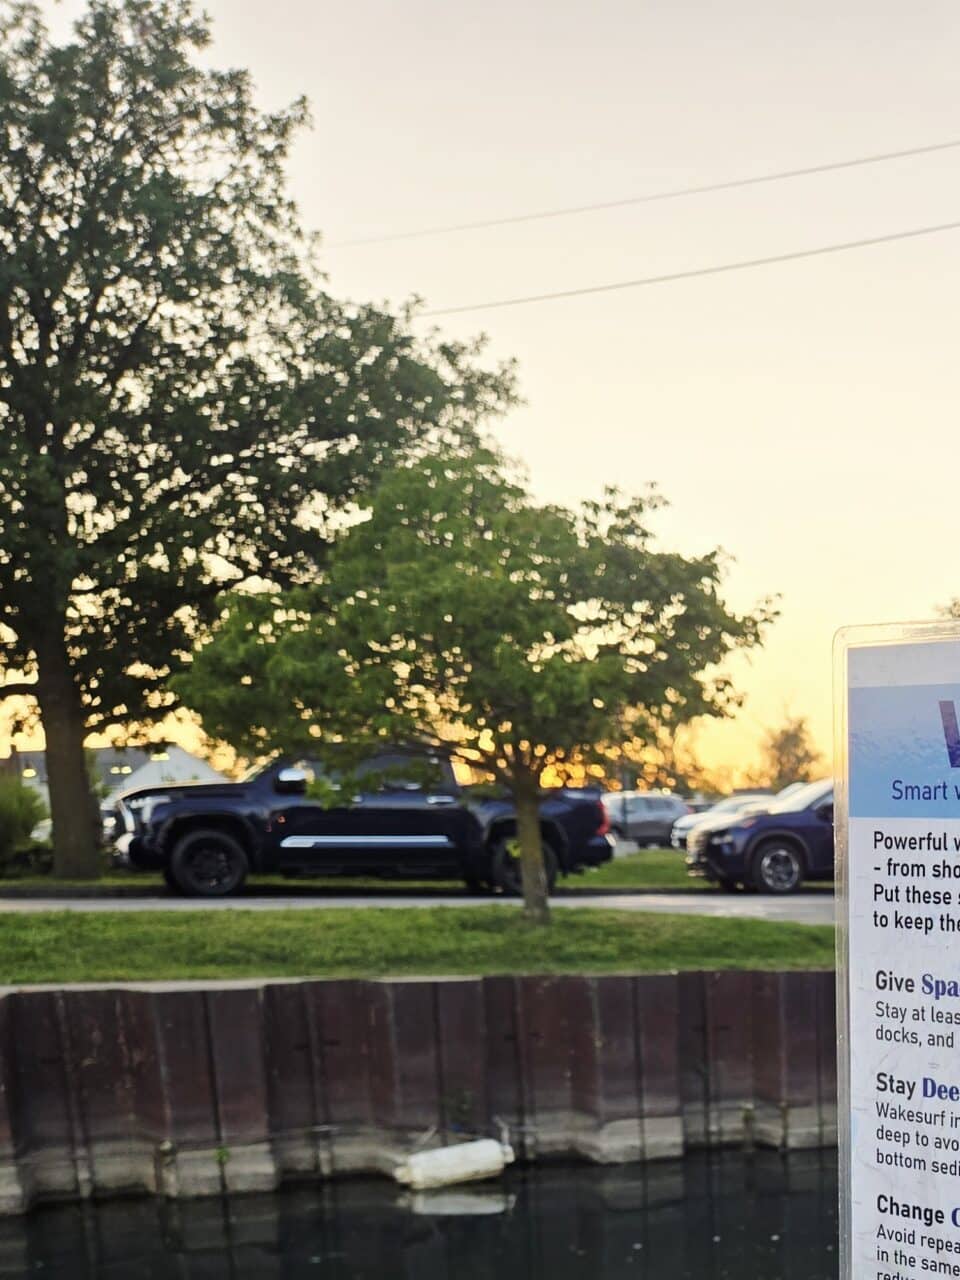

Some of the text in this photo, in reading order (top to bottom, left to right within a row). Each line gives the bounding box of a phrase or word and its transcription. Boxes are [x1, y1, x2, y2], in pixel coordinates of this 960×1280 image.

[892, 780, 947, 800] Smart
[874, 831, 947, 850] Powerful
[888, 858, 925, 877] from
[874, 884, 899, 902] Put
[906, 886, 951, 904] these
[874, 911, 888, 927] to
[895, 911, 933, 935] keep
[876, 971, 914, 992] Give
[876, 1001, 907, 1023] Stay
[912, 1007, 925, 1021] at
[876, 1025, 921, 1046] docks,
[928, 1032, 953, 1048] and
[877, 1073, 915, 1100] Stay
[876, 1102, 945, 1126] Wakesurf
[877, 1125, 910, 1147] deep
[916, 1132, 928, 1146] to
[877, 1148, 926, 1170] bottom
[878, 1195, 944, 1226] Change
[877, 1224, 915, 1248] Avoid
[877, 1246, 888, 1262] in
[894, 1250, 915, 1267] the
[922, 1259, 960, 1276] same
